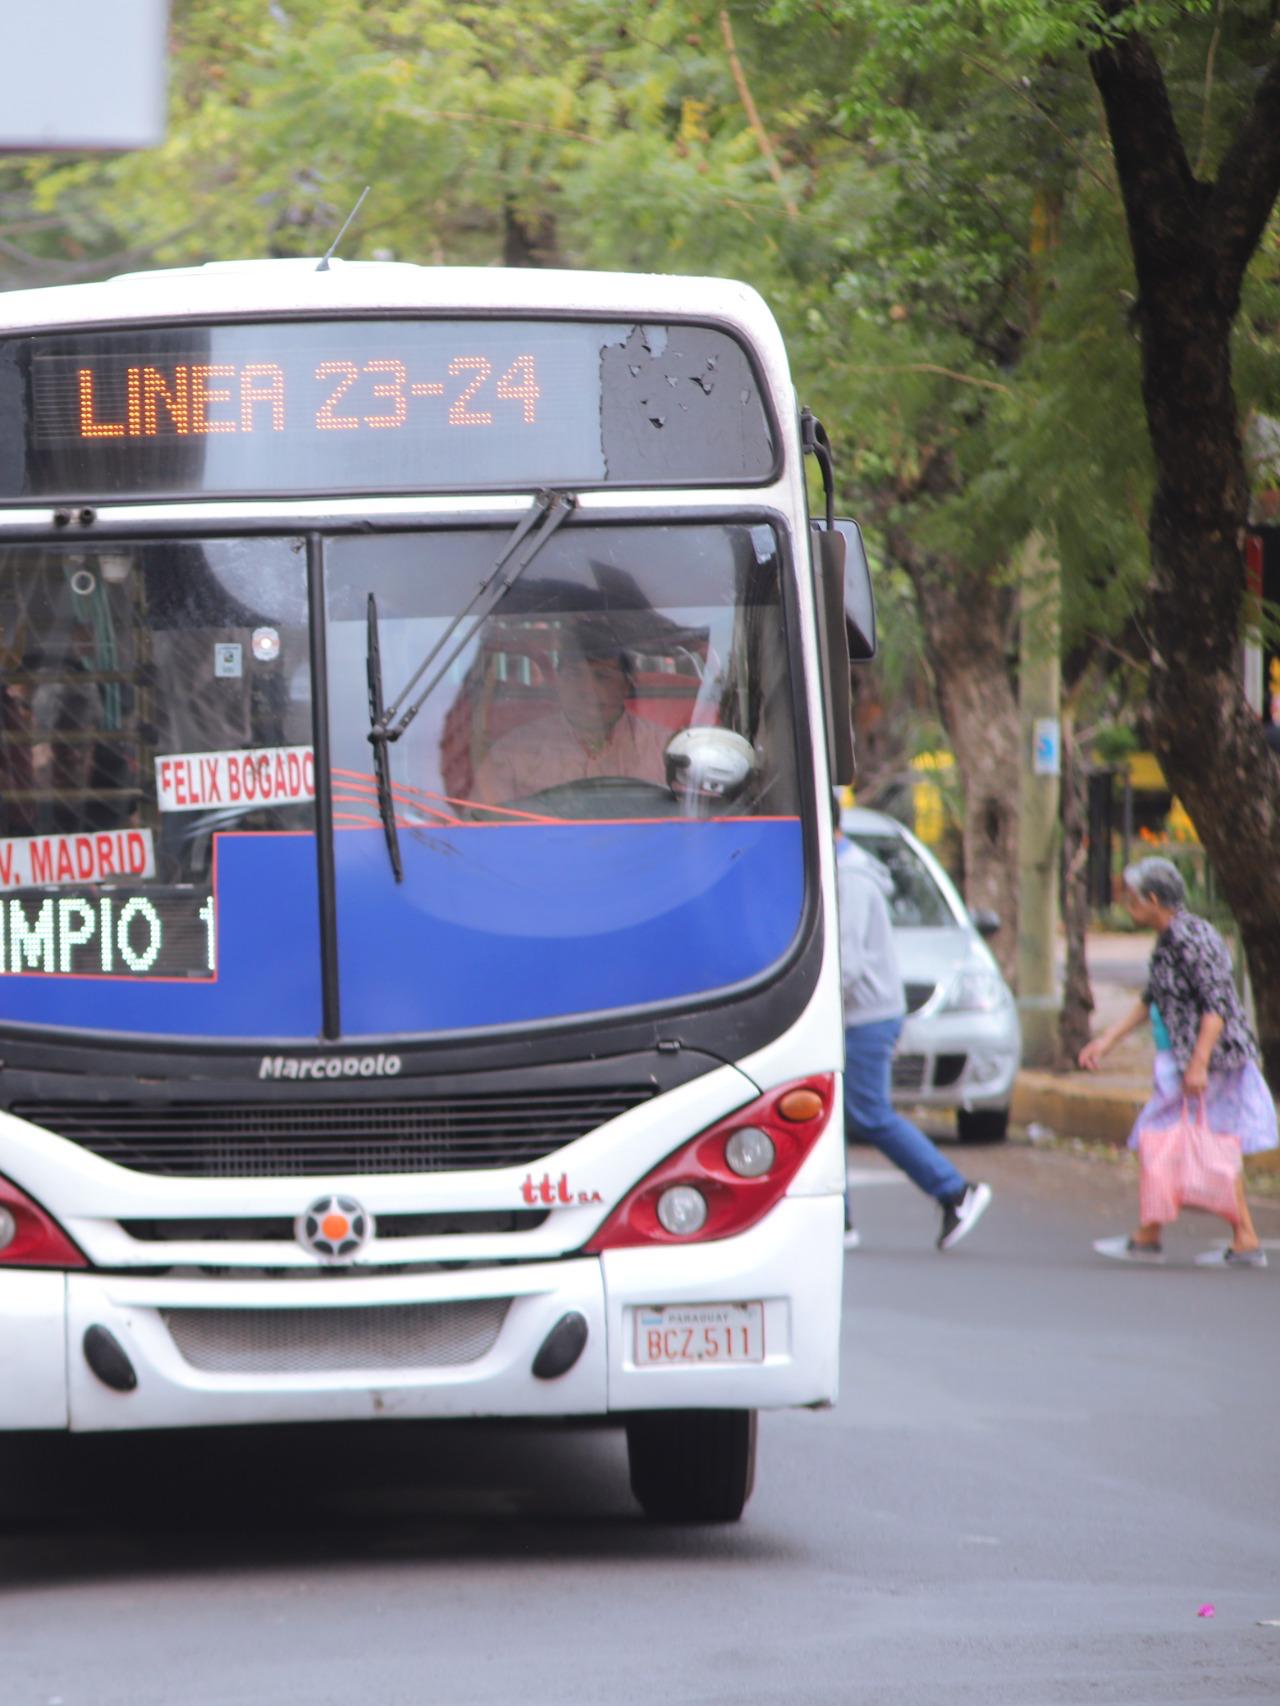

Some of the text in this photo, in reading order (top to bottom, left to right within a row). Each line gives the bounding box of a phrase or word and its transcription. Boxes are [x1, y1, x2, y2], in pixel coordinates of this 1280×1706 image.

[79, 354, 540, 437] LINEA 23-24
[161, 751, 315, 805] FELIX BOGADO
[29, 832, 146, 884] MADRID
[259, 1054, 401, 1079] Marcopolo
[668, 1313, 729, 1324] PARAGUAY
